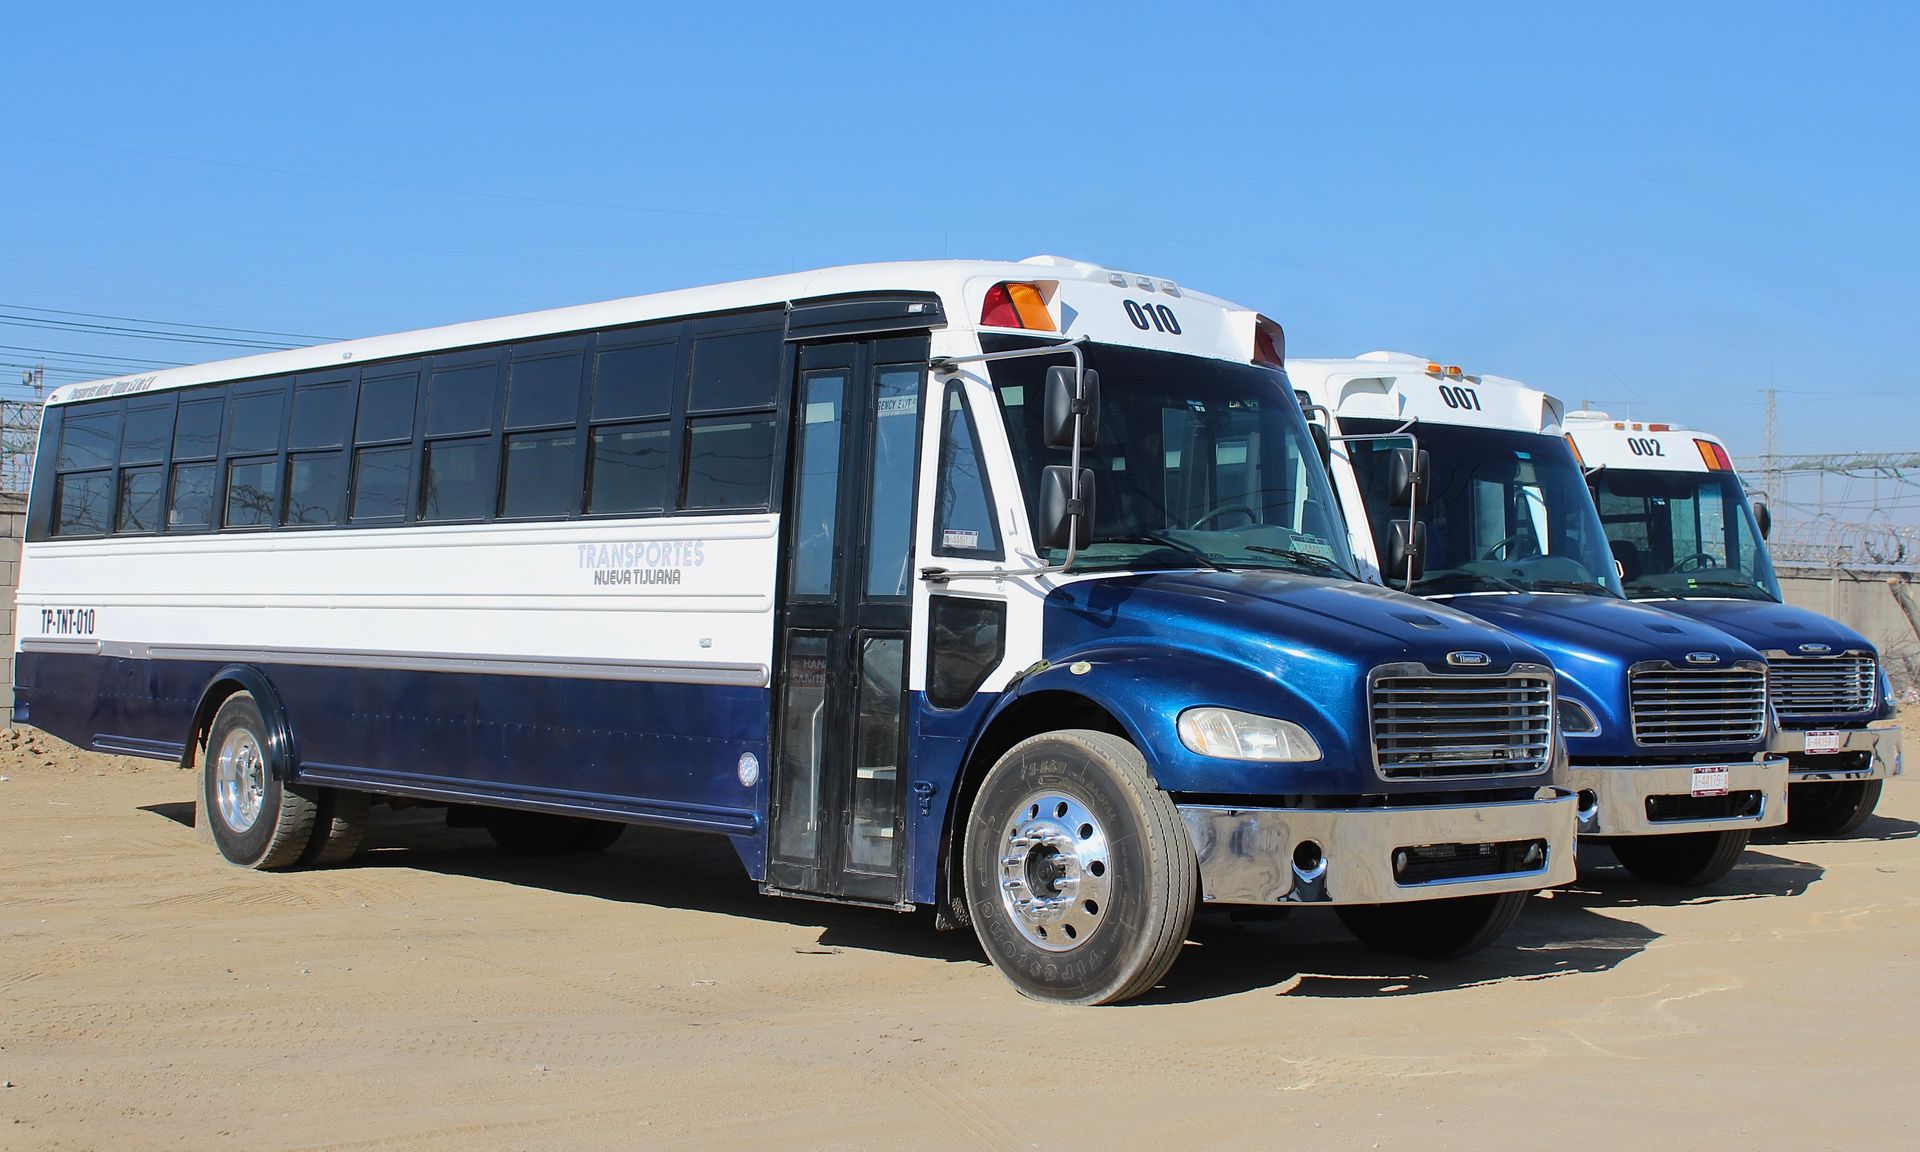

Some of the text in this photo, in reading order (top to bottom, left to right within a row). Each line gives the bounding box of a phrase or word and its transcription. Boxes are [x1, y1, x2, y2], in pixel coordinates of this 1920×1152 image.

[1123, 299, 1182, 335] 010
[1439, 385, 1481, 411] 007
[1627, 437, 1665, 456] 002
[577, 541, 704, 568] TRANSPORTES
[594, 569, 681, 585] NUEVA TIJUANA
[41, 608, 95, 635] TP-TNT-010
[803, 659, 826, 669] HAN
